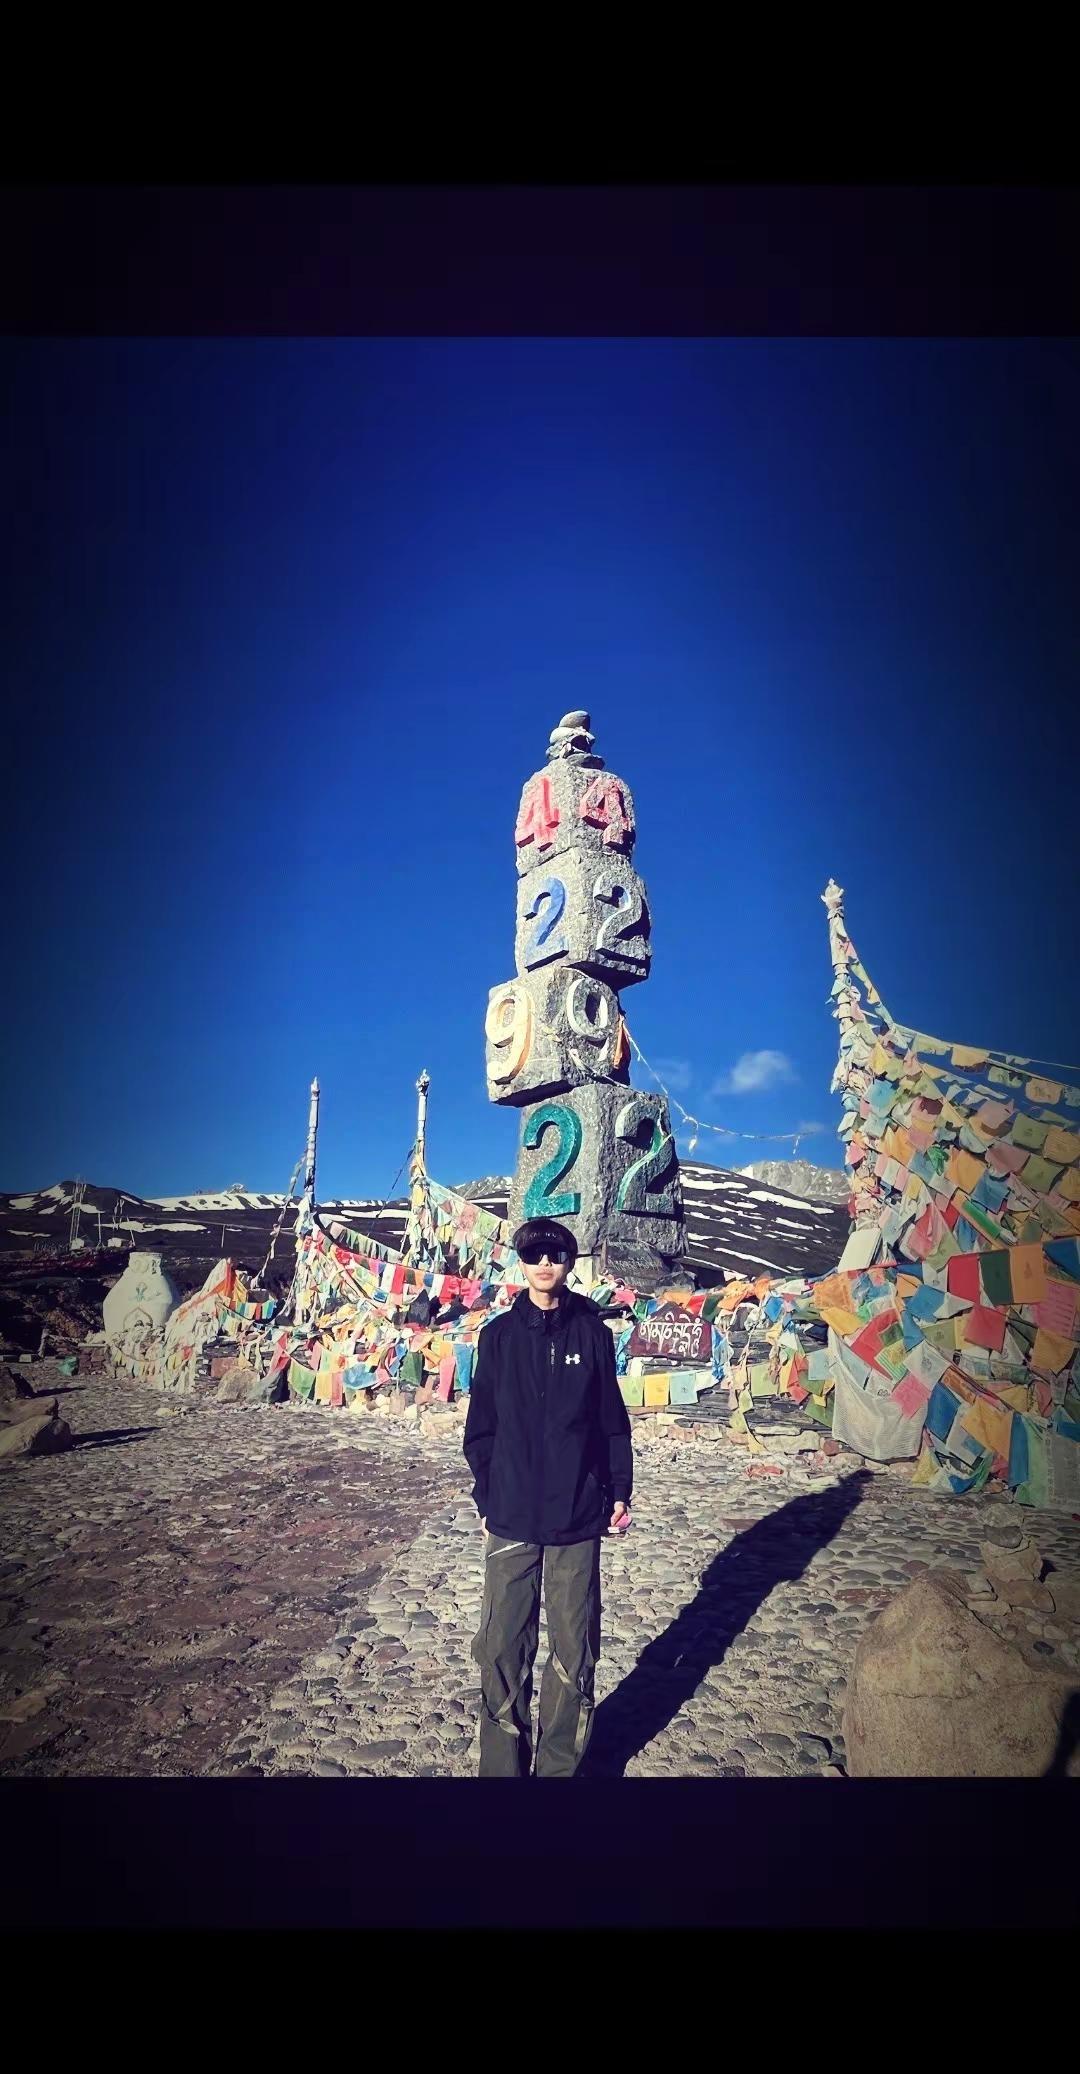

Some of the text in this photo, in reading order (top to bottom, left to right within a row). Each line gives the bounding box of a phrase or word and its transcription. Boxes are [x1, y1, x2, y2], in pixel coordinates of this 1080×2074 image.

[515, 775, 561, 852] 4
[579, 777, 636, 850] 4
[523, 876, 569, 972] 2
[593, 872, 652, 963] 2
[485, 985, 534, 1085] 9
[566, 978, 628, 1084] 9
[523, 1103, 582, 1219] 2
[615, 1101, 676, 1215] 2
